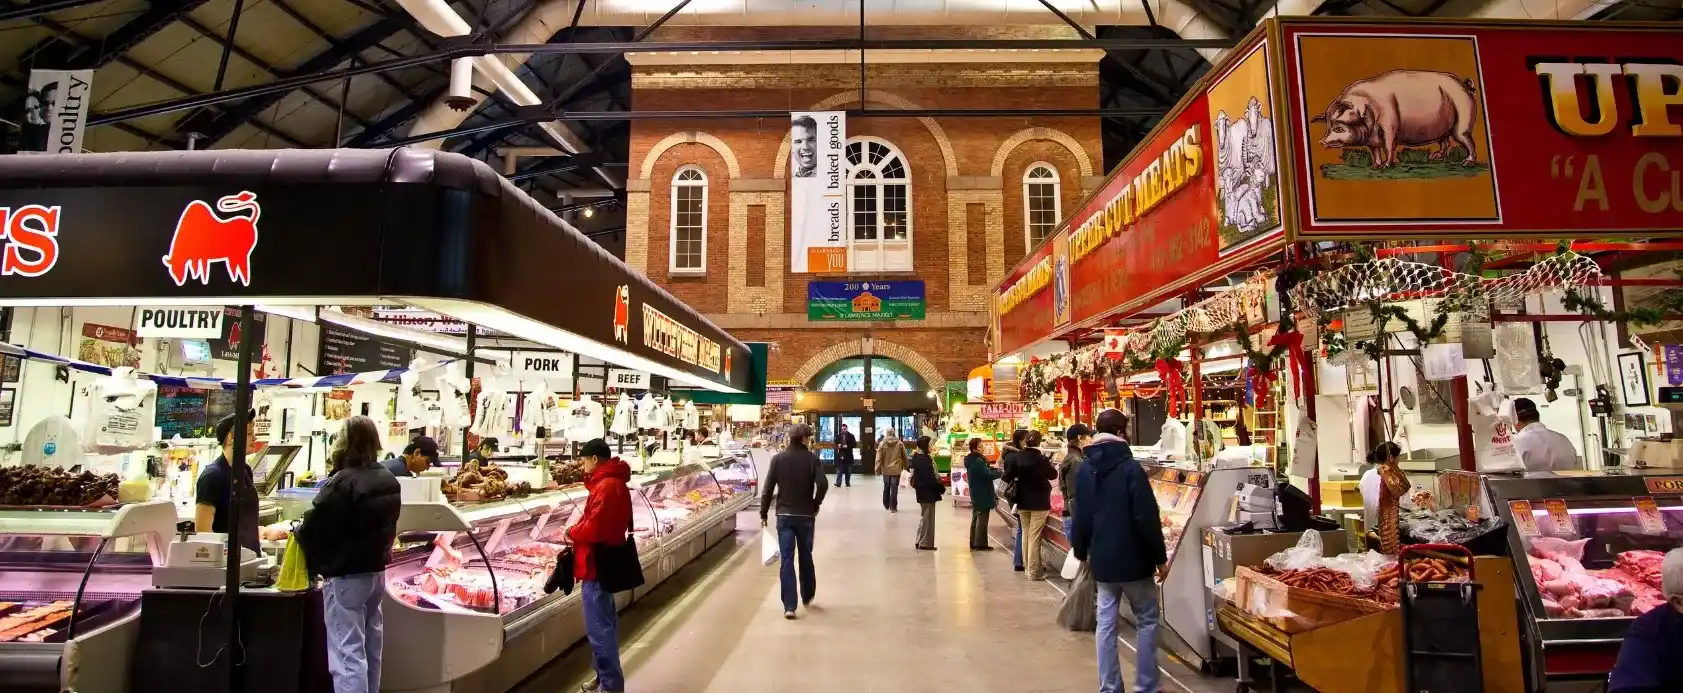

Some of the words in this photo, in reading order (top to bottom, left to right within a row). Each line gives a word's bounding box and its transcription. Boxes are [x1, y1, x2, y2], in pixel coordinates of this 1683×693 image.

[1535, 62, 1683, 137] UP
[829, 115, 842, 150] goods
[827, 154, 839, 189] baked
[1068, 210, 1105, 265] UPPER
[1105, 184, 1133, 238] CUT
[1134, 124, 1203, 217] MEATS
[828, 202, 839, 242] breads
[844, 283, 859, 291] 200
[141, 309, 221, 329] POULTRY
[525, 357, 560, 372] PORK
[617, 373, 641, 384] BEEF
[981, 403, 1024, 413] TAKE-OUT
